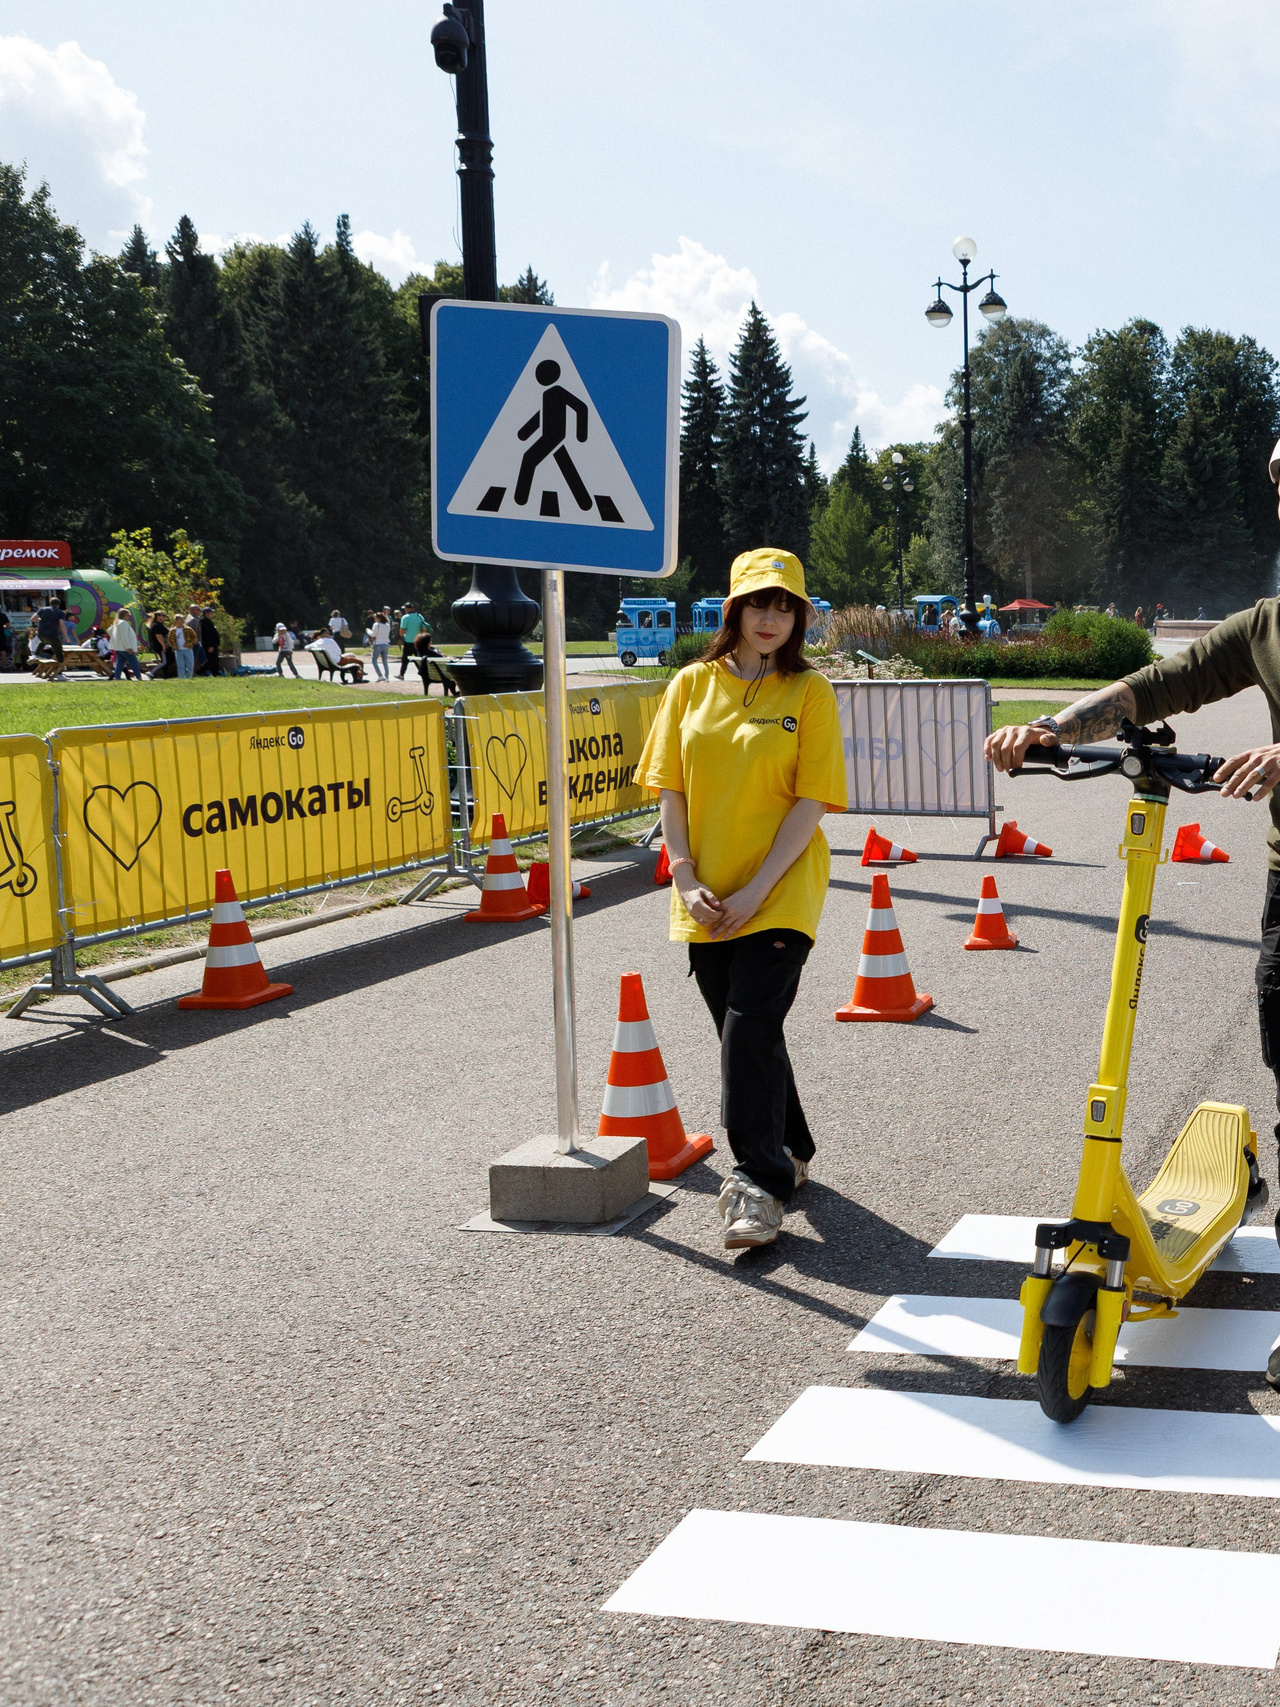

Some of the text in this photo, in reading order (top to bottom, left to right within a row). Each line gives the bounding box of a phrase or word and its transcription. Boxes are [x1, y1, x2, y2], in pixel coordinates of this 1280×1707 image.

[0, 547, 59, 561] ремок
[783, 718, 796, 731] Go
[249, 731, 304, 750] Яндекс Go
[182, 777, 371, 838] самокаты
[1164, 1201, 1194, 1214] Go
